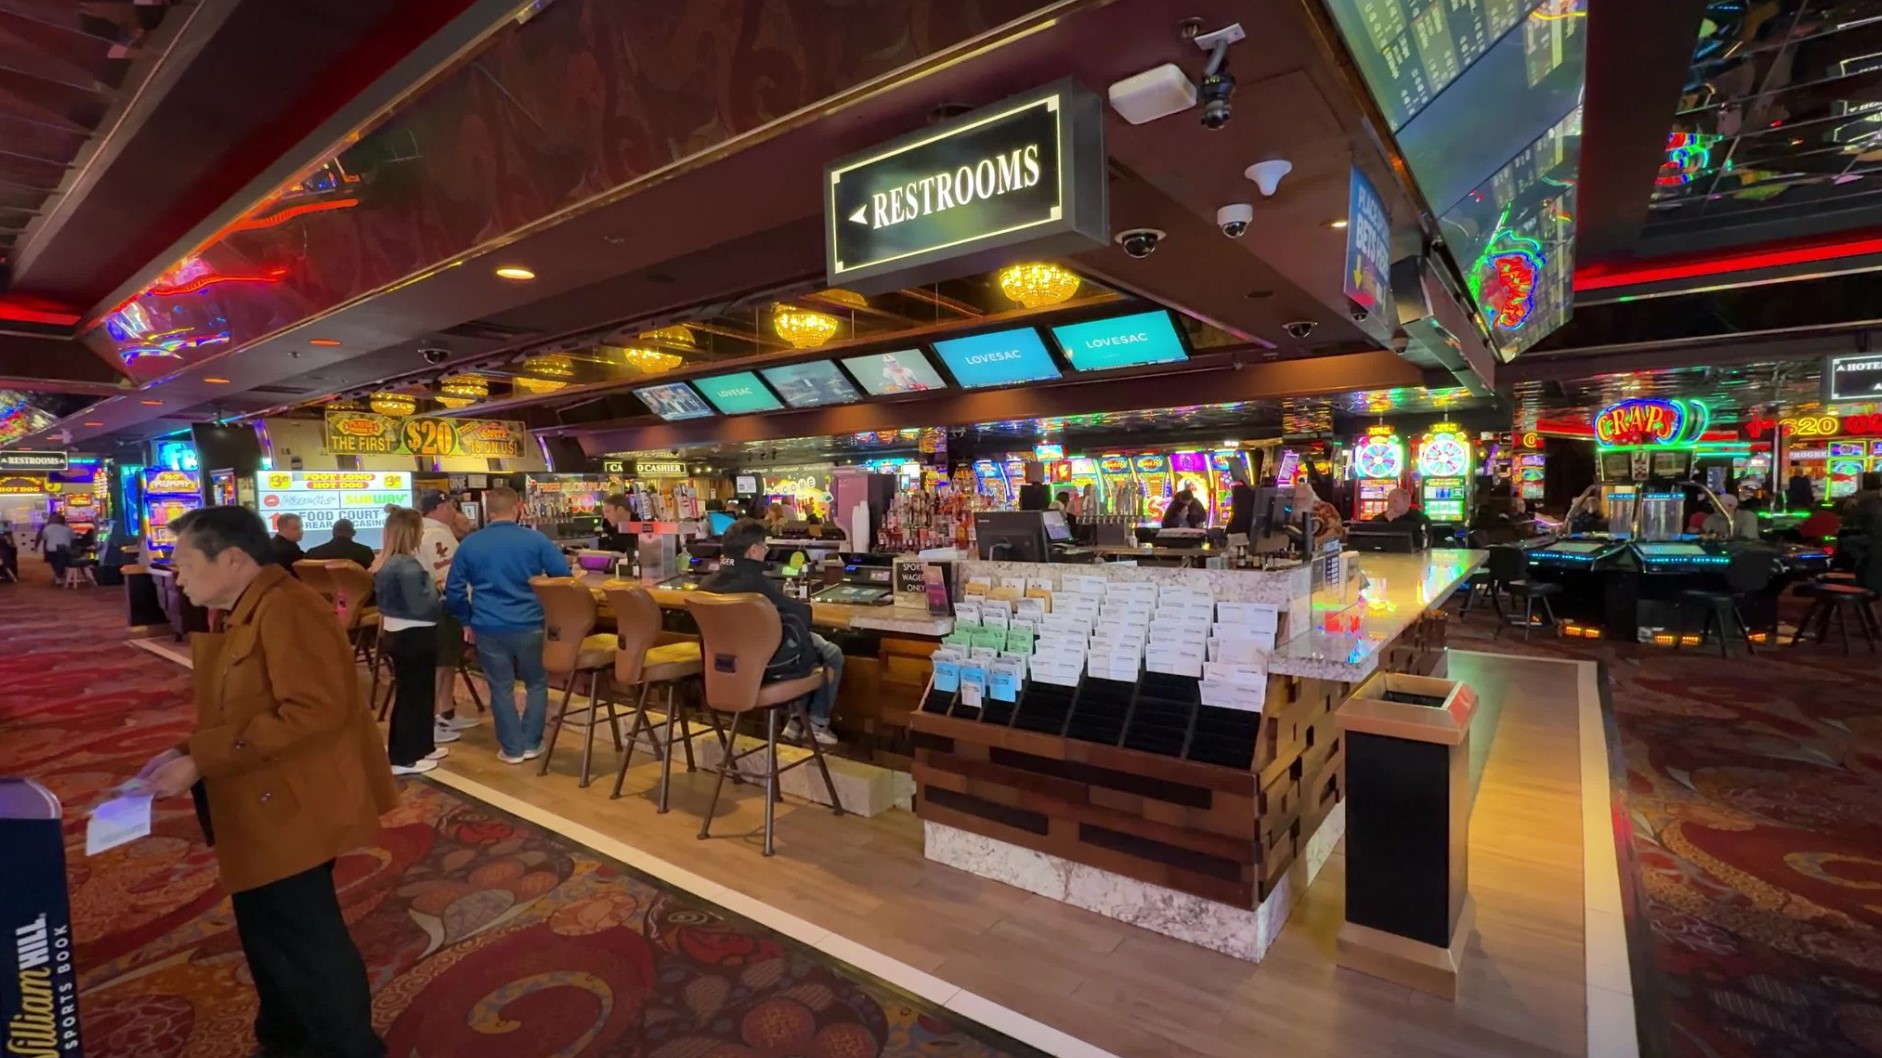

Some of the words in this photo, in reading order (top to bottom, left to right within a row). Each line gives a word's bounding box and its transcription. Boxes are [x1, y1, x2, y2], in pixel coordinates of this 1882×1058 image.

[872, 144, 1040, 229] RESTROOMS
[1356, 212, 1376, 263] BETS
[1085, 333, 1148, 349] LOVESAC
[965, 349, 1022, 365] LOVESAC
[1847, 361, 1882, 371] HOTE
[717, 386, 753, 398] LOVESAC
[1598, 406, 1676, 441] CRAPS
[331, 436, 356, 450] THE
[358, 437, 393, 452] FIRST
[407, 421, 452, 454] $20
[472, 441, 481, 453] IS
[484, 441, 499, 454] ON
[8, 456, 59, 464] RESTROOMS
[345, 494, 407, 505] SUBWAY
[299, 511, 334, 521] FOOD
[339, 510, 379, 520] COURT
[305, 521, 333, 529] REAR
[354, 519, 386, 528] CASIN
[903, 563, 922, 571] SPOR
[906, 584, 925, 592] ONLY
[16, 915, 50, 970] HILL
[54, 924, 71, 974] BOOK
[58, 982, 78, 1050] SPORTS
